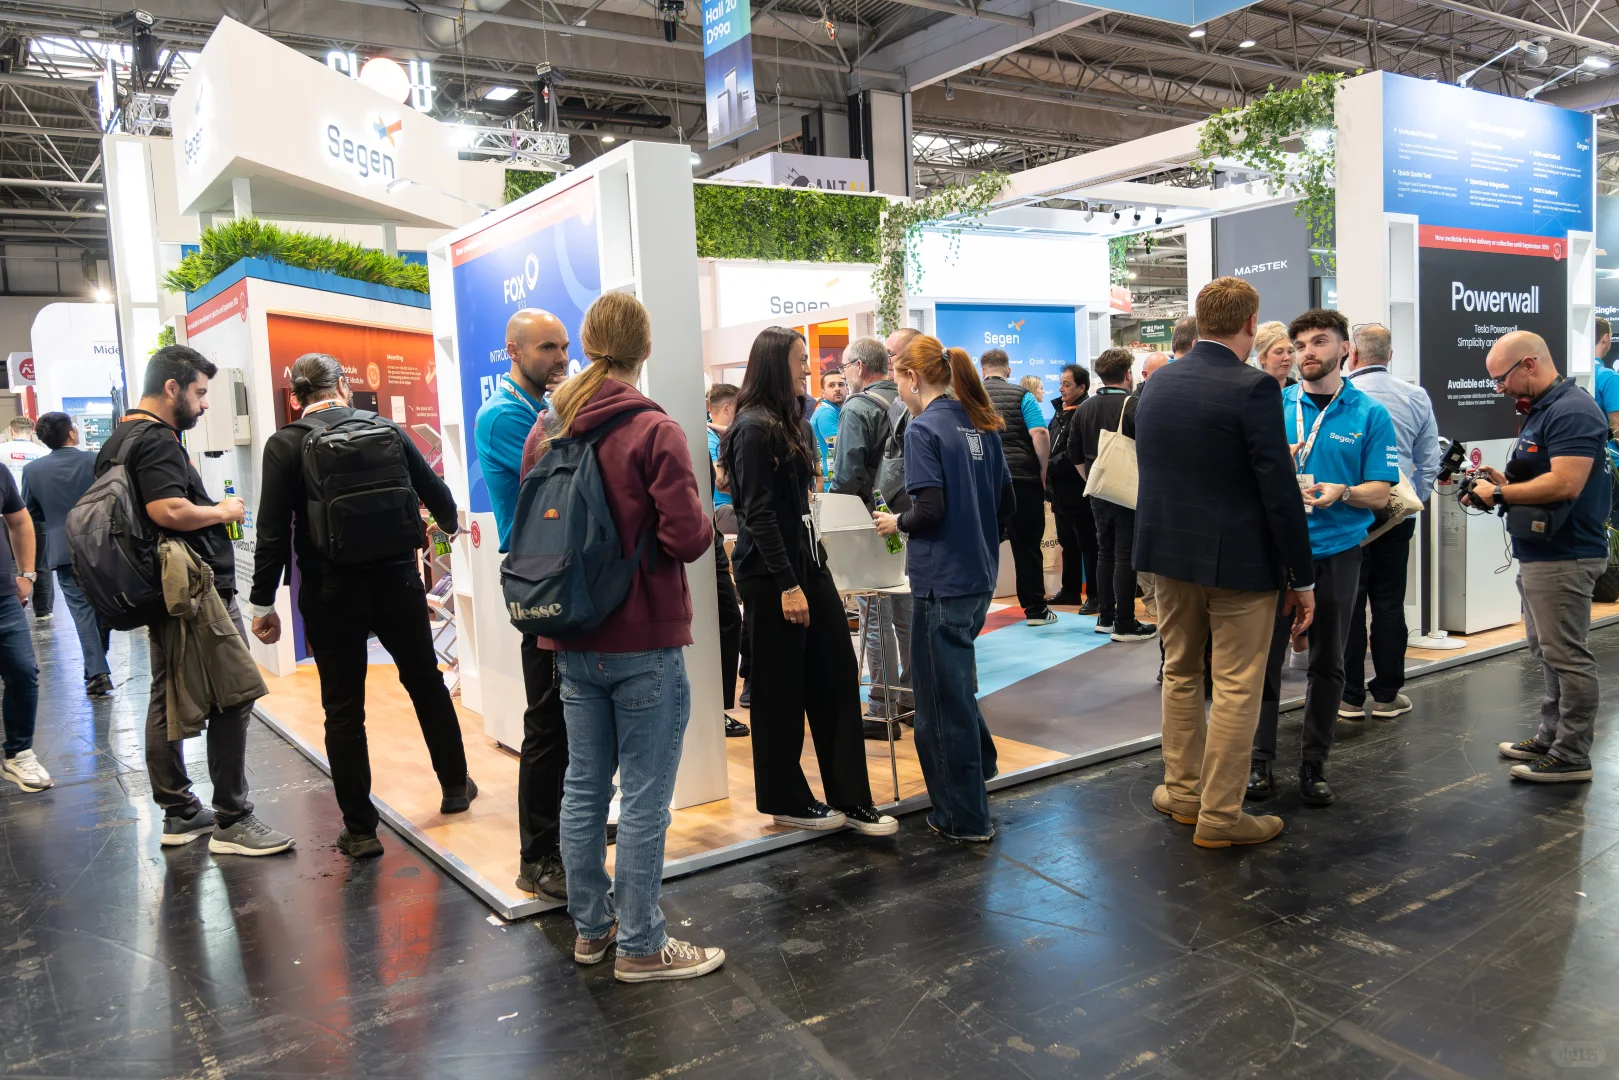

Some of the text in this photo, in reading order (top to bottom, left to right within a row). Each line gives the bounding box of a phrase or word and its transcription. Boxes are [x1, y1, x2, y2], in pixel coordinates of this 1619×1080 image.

[706, 3, 724, 25] Hall
[706, 21, 731, 45] D99a
[327, 124, 395, 179] Segen
[1576, 142, 1590, 152] Segen
[1397, 169, 1410, 177] Quick
[1444, 235, 1462, 243] available
[1477, 238, 1492, 247] delivery
[1496, 239, 1513, 247] collection
[1522, 241, 1541, 250] September
[1234, 259, 1288, 276] MARSTEK
[503, 273, 526, 304] FOX
[518, 299, 527, 309] ESS
[1451, 281, 1540, 314] Powerwall
[1474, 324, 1518, 334] Tesla Powerwall
[984, 331, 1020, 347] Segen
[1457, 337, 1486, 350] Simplicity
[350, 377, 364, 385] Module
[1447, 379, 1477, 390] Available
[1478, 379, 1485, 388] at
[1329, 432, 1355, 445] Segen
[508, 601, 563, 620] llesse
